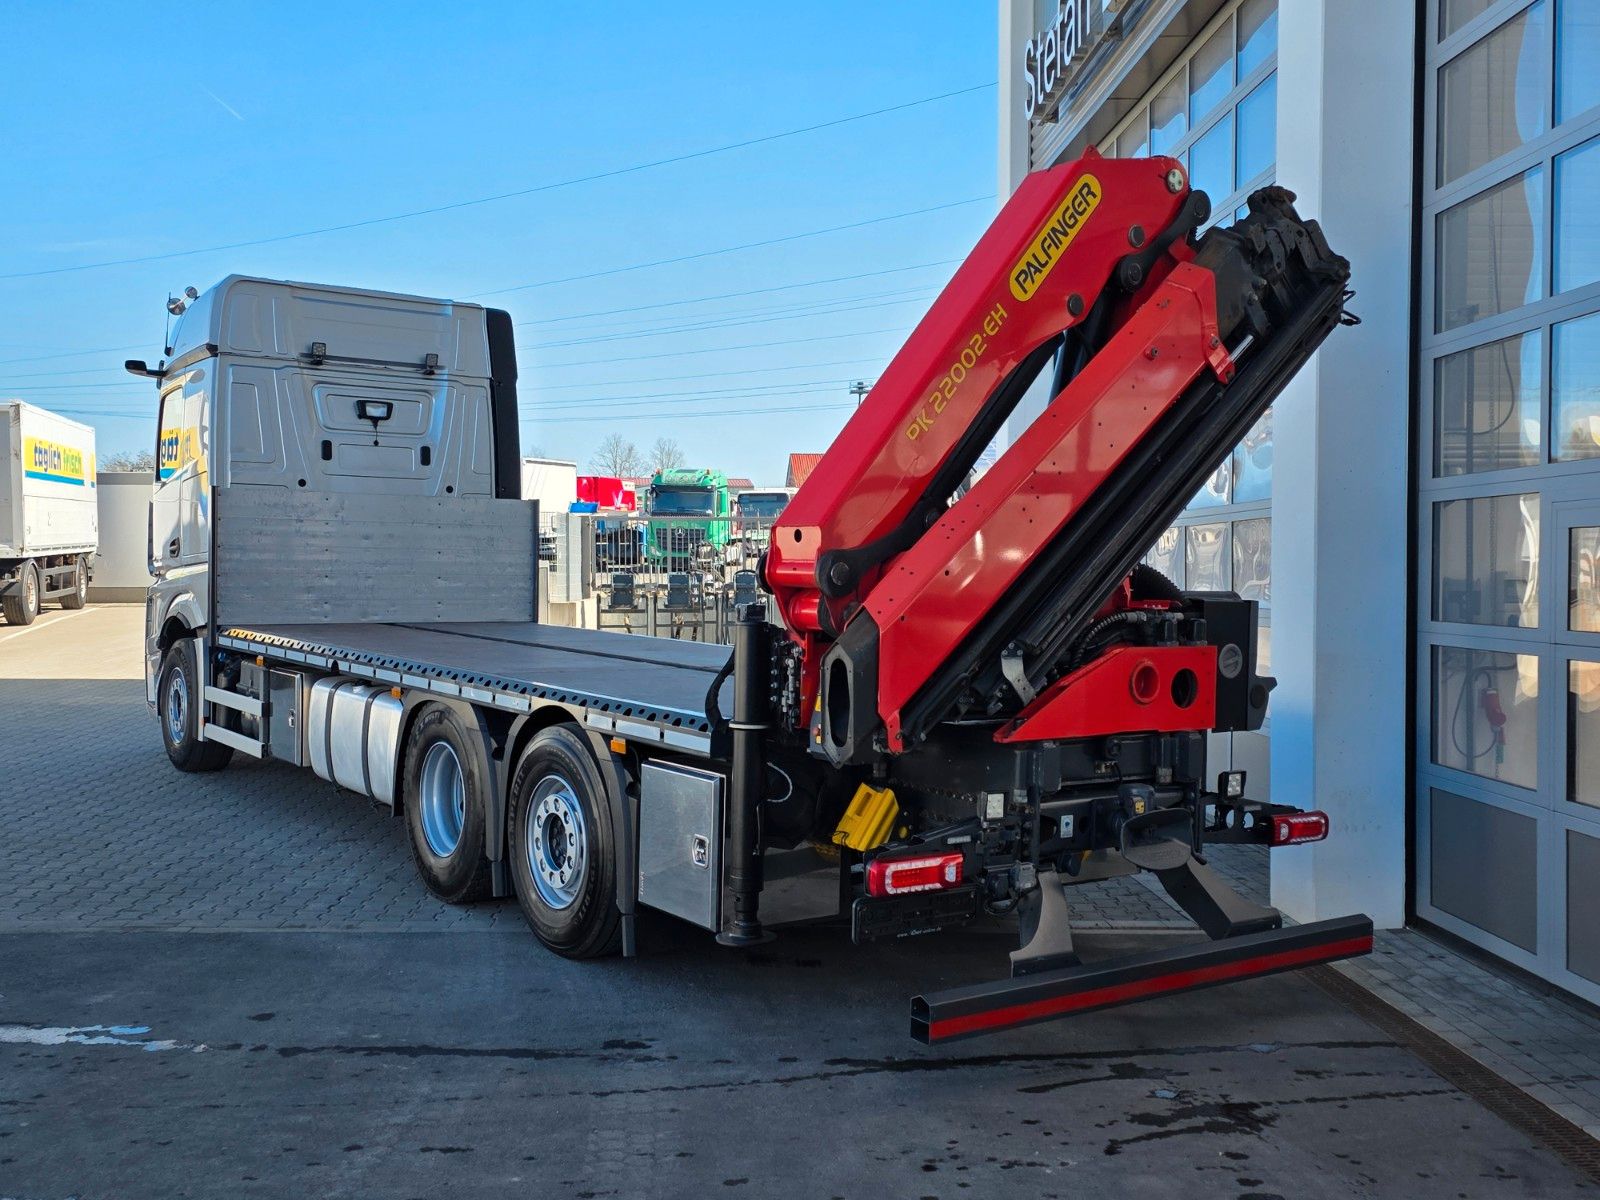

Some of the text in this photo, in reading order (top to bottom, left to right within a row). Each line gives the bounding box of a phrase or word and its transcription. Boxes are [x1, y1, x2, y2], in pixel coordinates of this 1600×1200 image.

[1014, 182, 1098, 295] PALFINGER
[907, 409, 935, 442] PK
[34, 441, 62, 472] täglich
